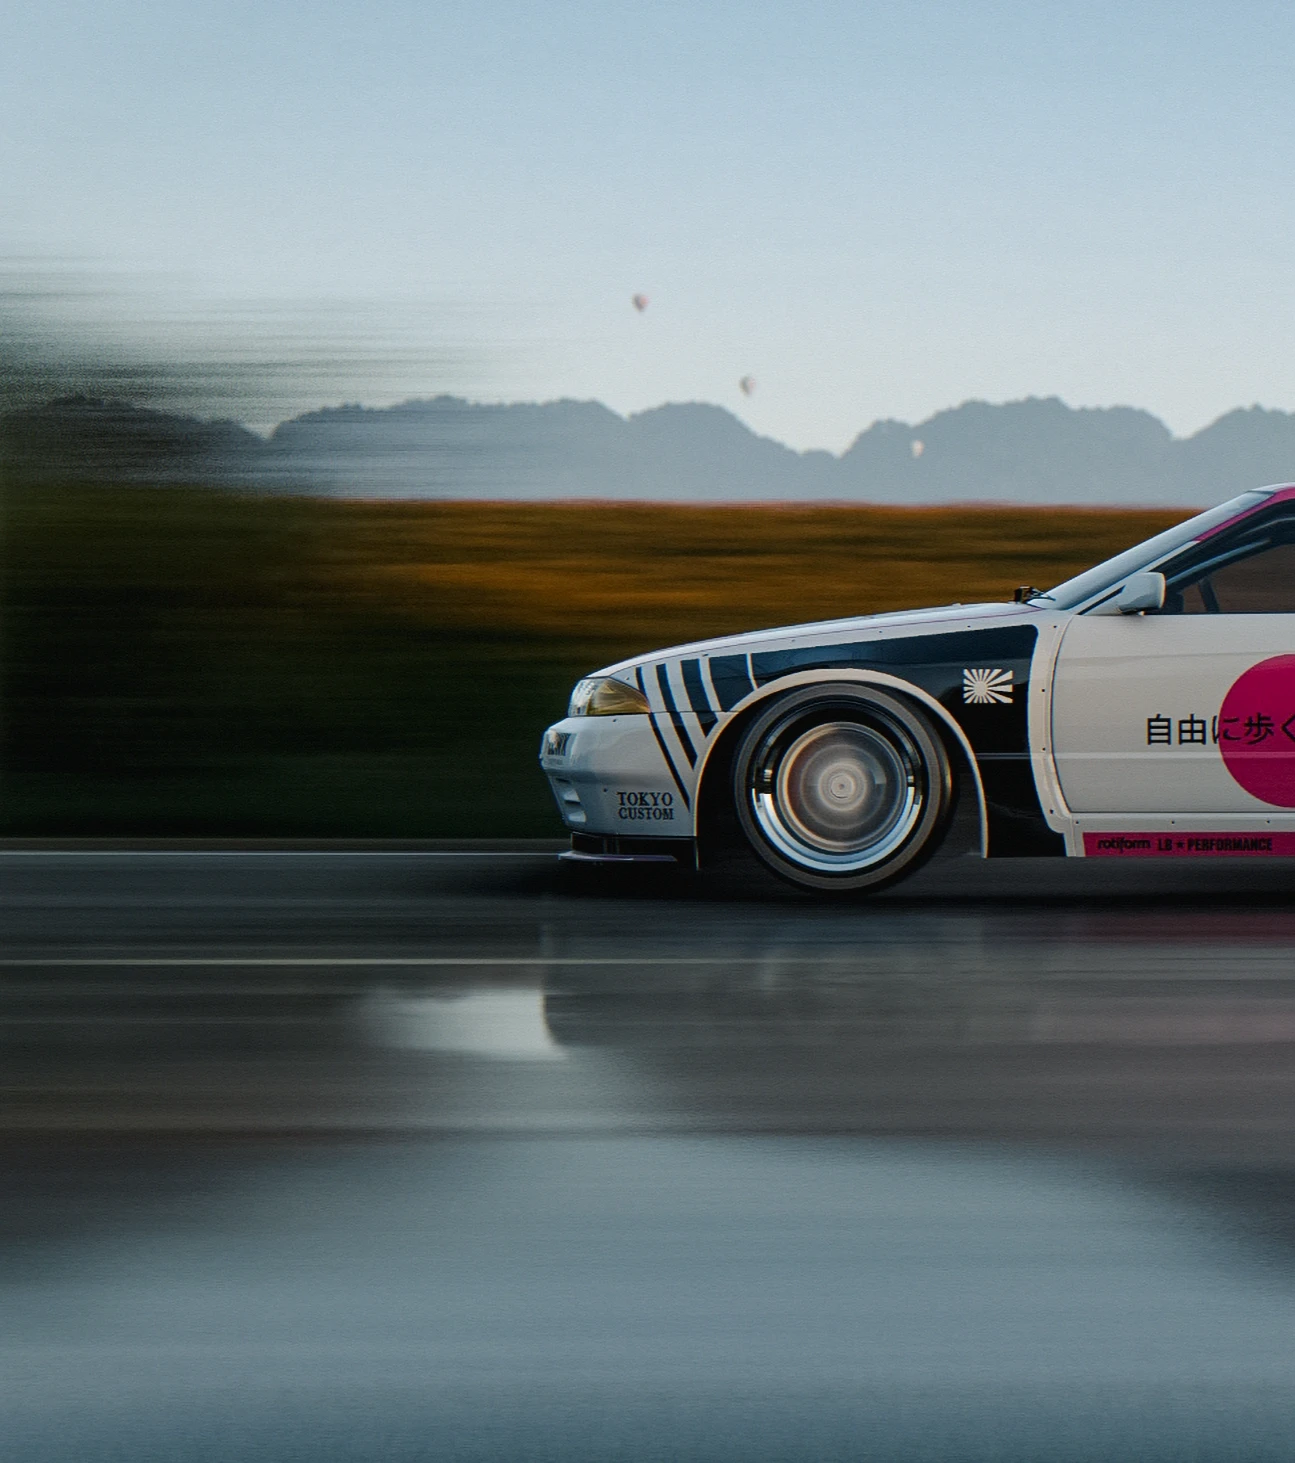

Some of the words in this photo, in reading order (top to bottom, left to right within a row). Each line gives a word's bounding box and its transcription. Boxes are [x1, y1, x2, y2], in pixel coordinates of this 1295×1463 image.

[617, 792, 673, 806] TOKYO
[618, 807, 674, 820] CUSTOM
[1097, 836, 1151, 853] rotiform
[1157, 838, 1173, 852] LB
[1186, 837, 1273, 852] PERFORMANCE
